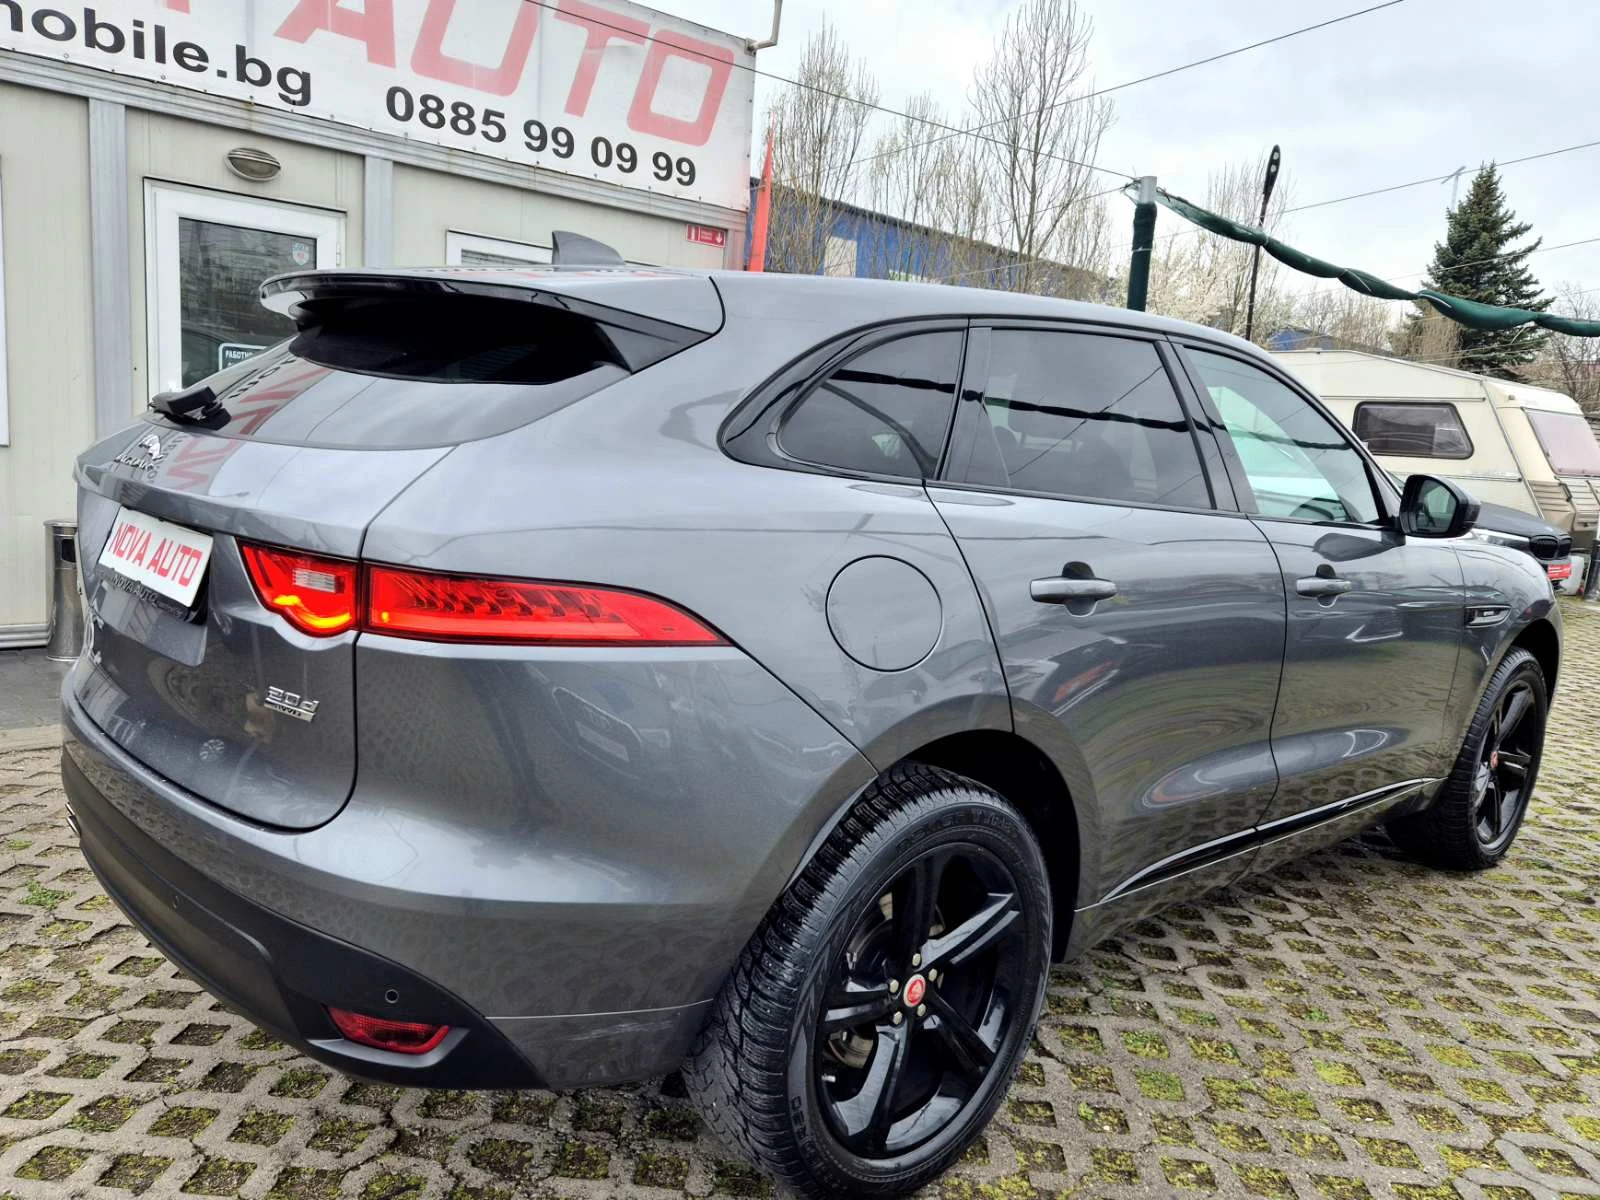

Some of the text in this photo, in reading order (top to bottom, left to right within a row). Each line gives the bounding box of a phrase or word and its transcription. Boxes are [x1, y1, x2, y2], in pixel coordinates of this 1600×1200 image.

[385, 86, 697, 187] 0885 99 09 99
[108, 521, 203, 588] NOVA AUTO
